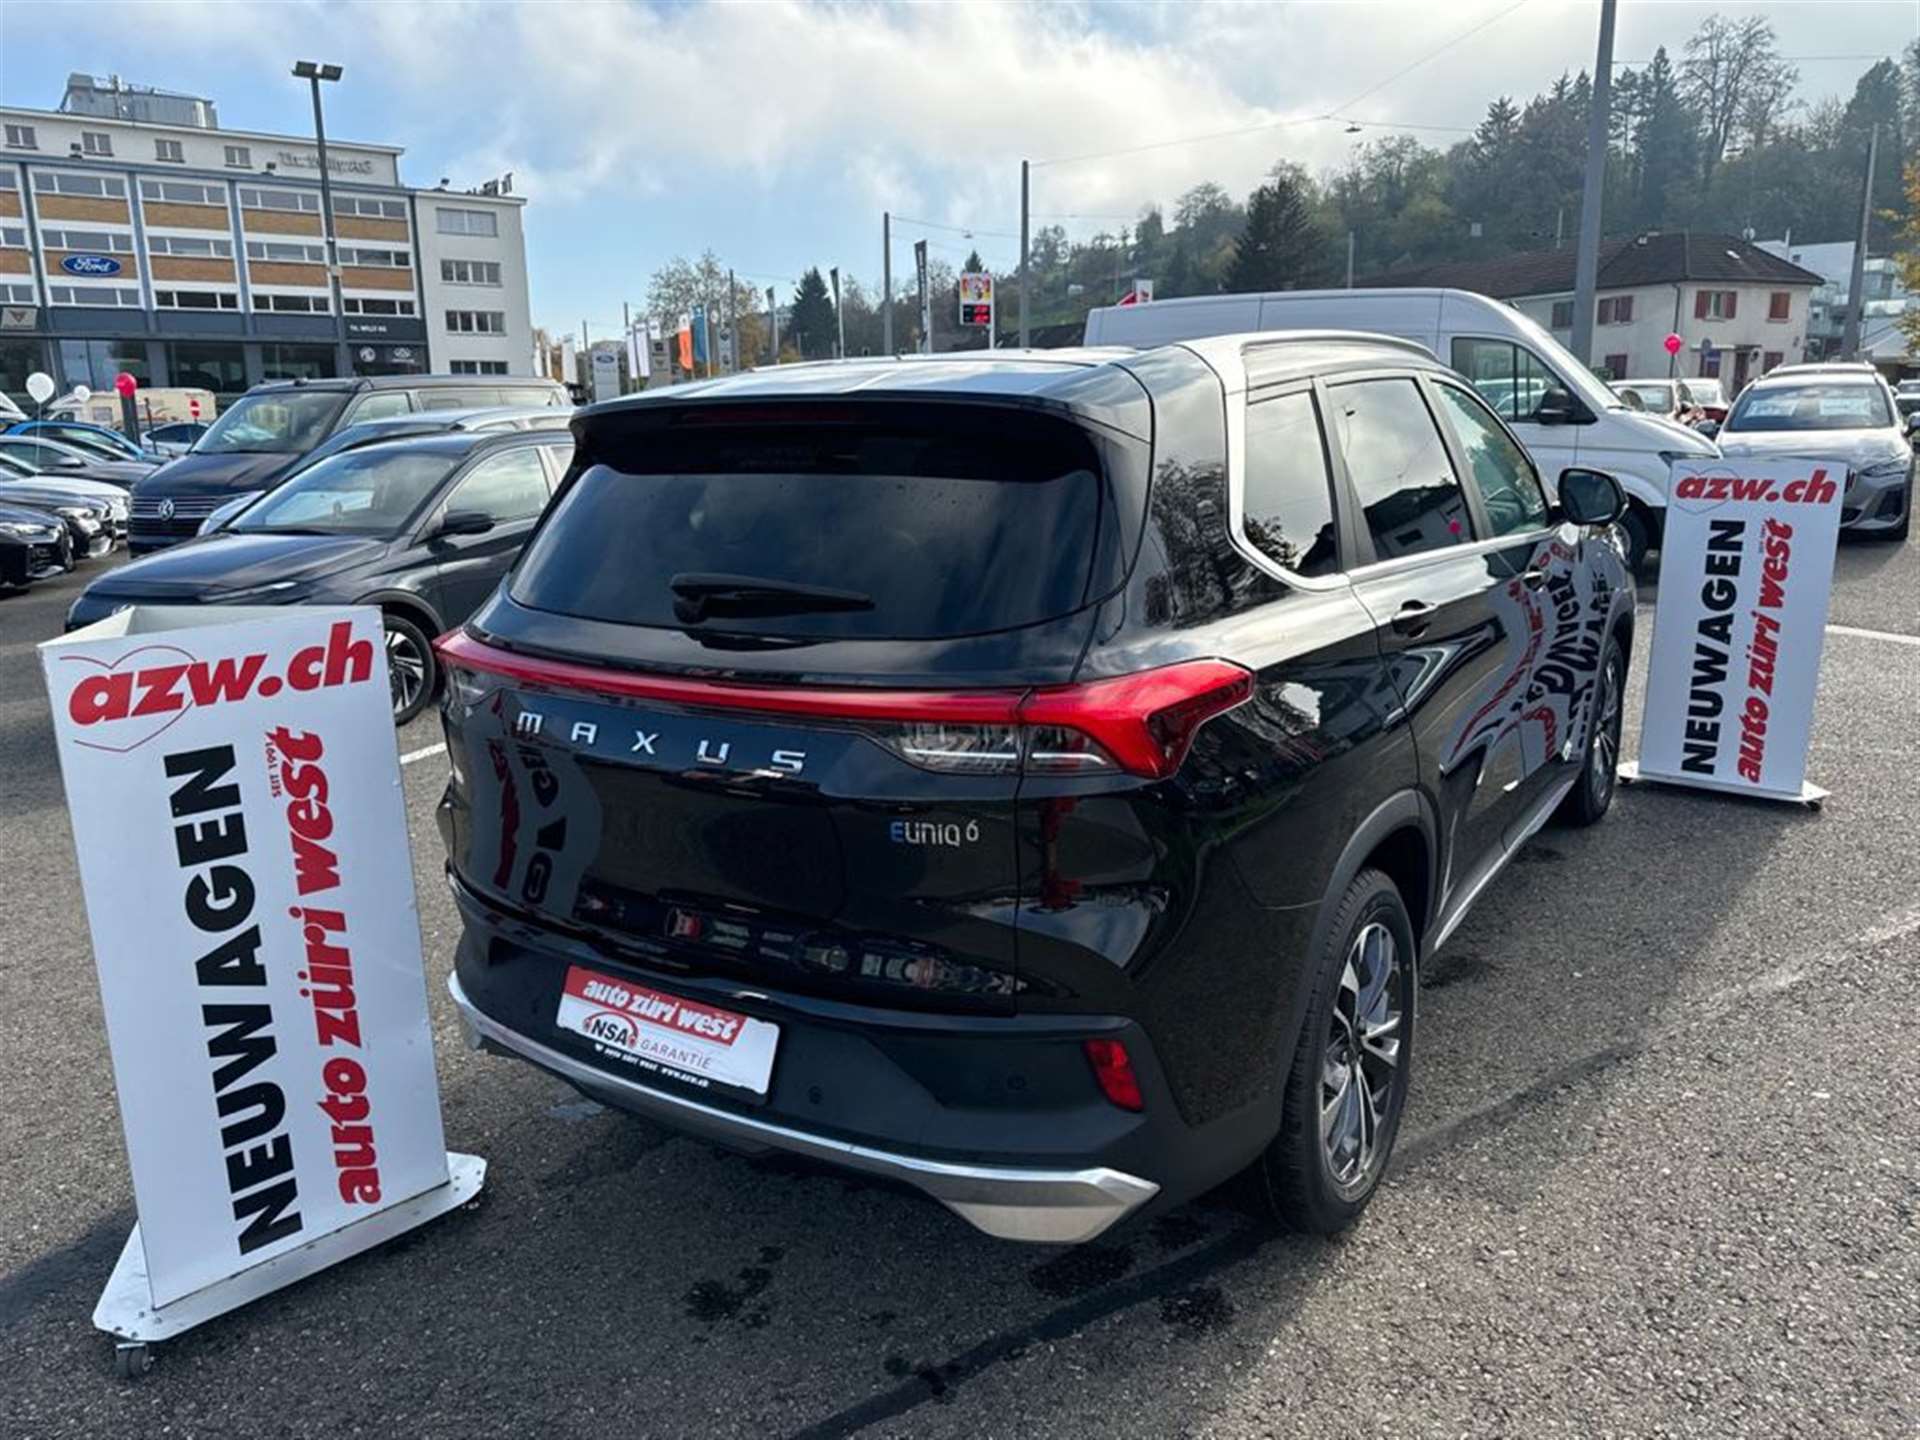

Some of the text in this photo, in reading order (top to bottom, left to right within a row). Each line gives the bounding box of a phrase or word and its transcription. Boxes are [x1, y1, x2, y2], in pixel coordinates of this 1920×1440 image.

[73, 257, 111, 272] Ford
[1676, 469, 1837, 504] azw.ch
[69, 621, 374, 726] azw.ch
[1681, 520, 1746, 776] NEUWAGEN
[1737, 517, 1793, 784] auto züri west
[516, 710, 806, 774] MAXUS
[269, 773, 282, 799] SEIT
[966, 818, 980, 843] 6
[265, 726, 382, 1205] auto züri west
[164, 744, 303, 1256] NEUWAGEN
[583, 979, 738, 1041] auto züri west
[591, 1018, 629, 1045] NSA
[640, 1038, 713, 1070] GARANTIE
